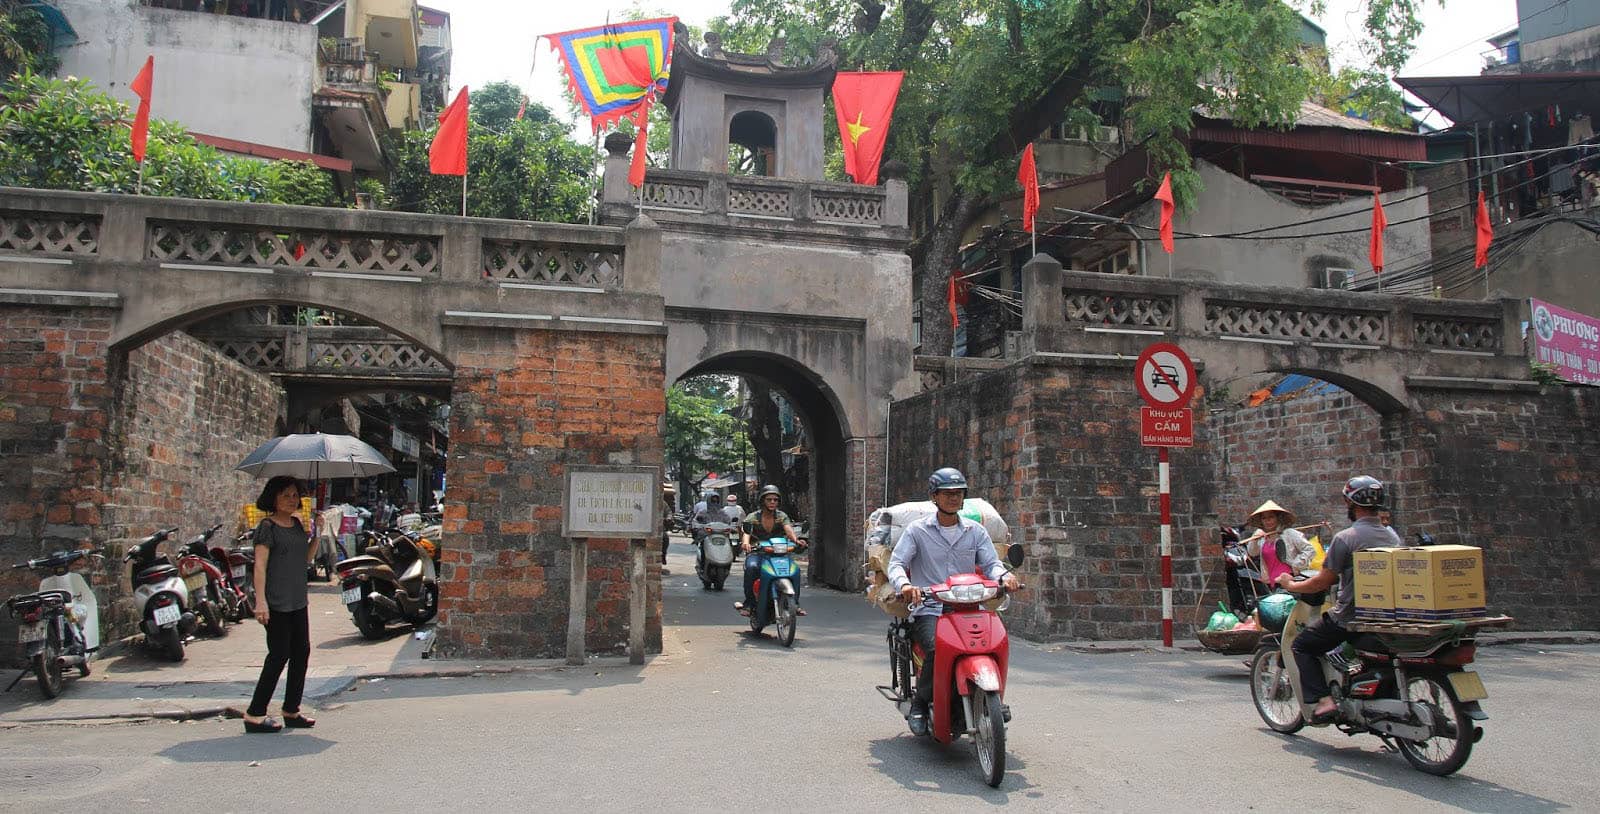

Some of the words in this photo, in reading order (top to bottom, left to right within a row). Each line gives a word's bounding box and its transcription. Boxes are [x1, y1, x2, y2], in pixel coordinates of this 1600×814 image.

[1552, 314, 1599, 342] PHƯƠNG
[1150, 410, 1166, 418] KHU
[1155, 419, 1180, 431] CẤM
